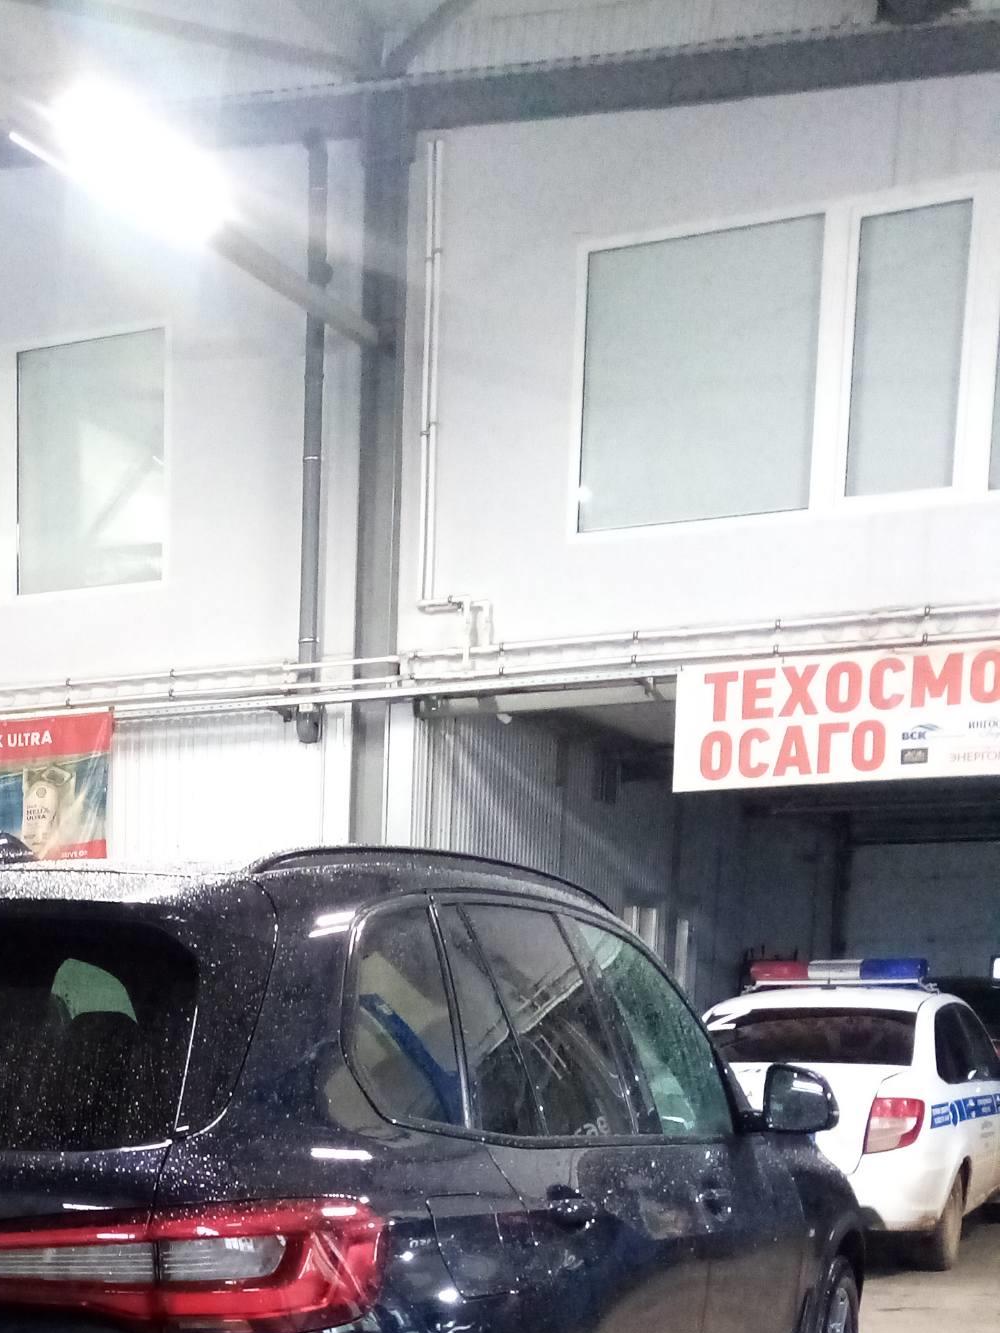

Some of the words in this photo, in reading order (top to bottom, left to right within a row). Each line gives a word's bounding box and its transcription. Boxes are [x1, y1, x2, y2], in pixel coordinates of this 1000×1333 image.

[703, 649, 1000, 723] ТЕХОСМО
[7, 730, 53, 748] ULTRA
[902, 731, 927, 740] ВСК
[699, 719, 887, 781] ОСАГО
[949, 751, 1000, 763] ЭНЕРГО
